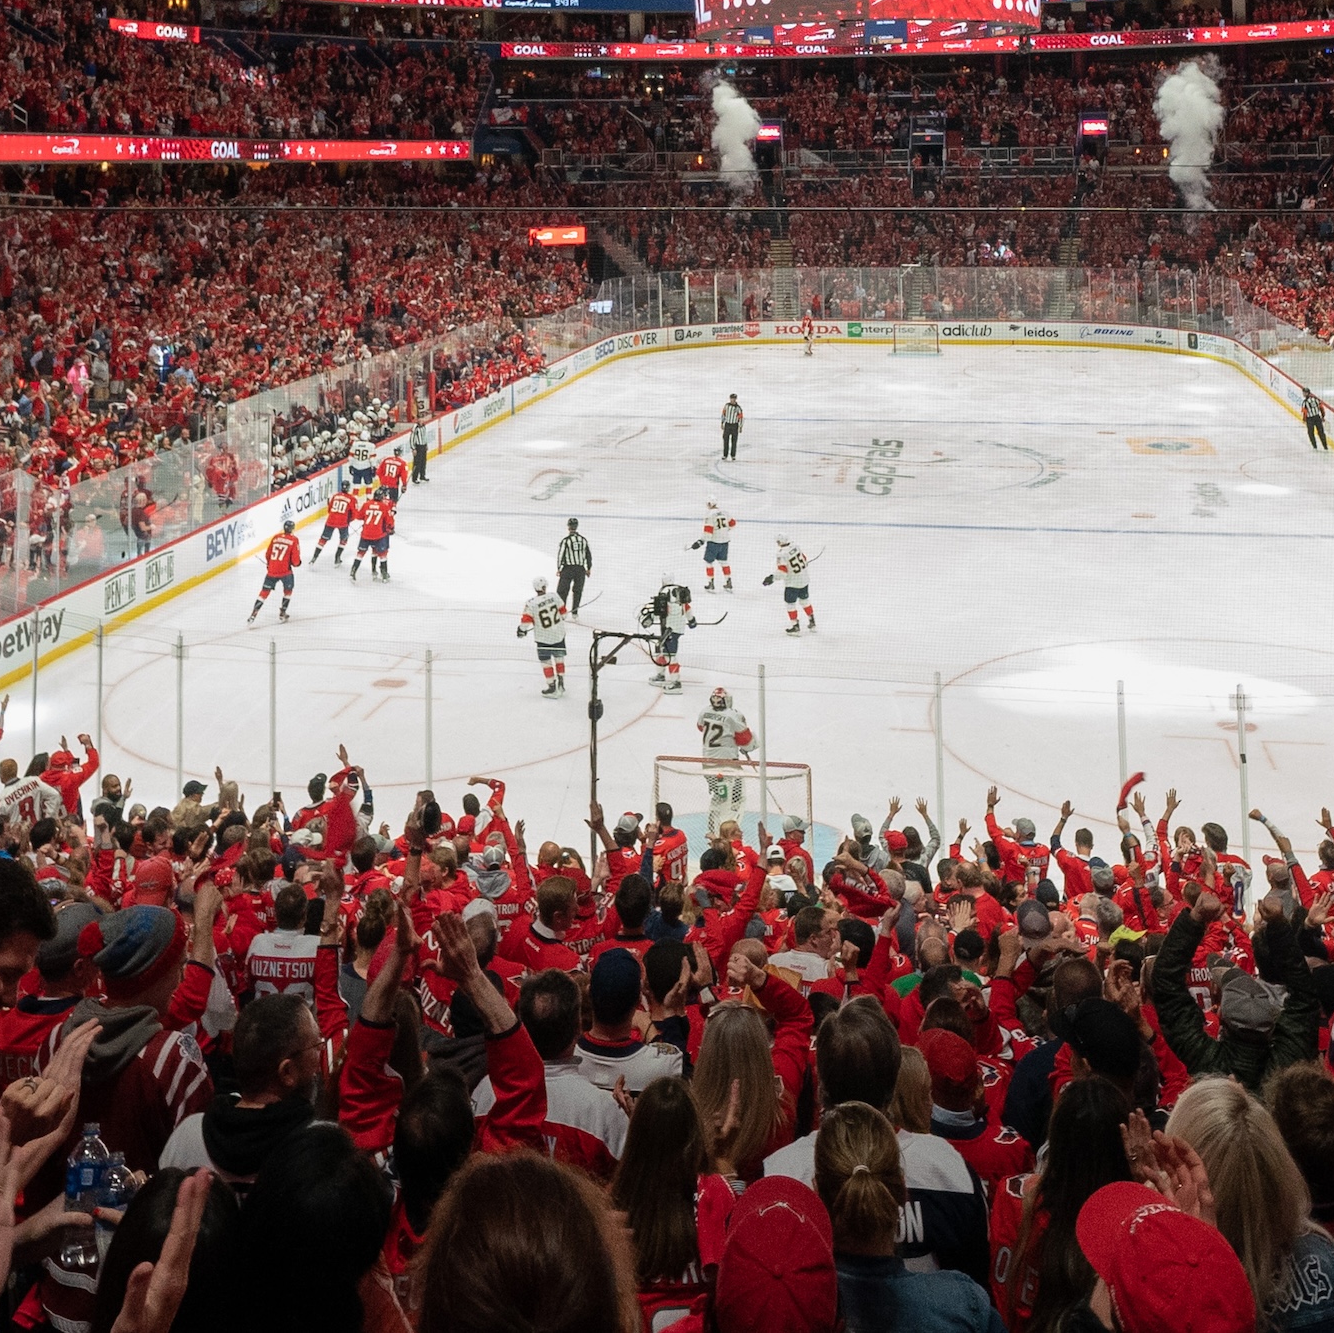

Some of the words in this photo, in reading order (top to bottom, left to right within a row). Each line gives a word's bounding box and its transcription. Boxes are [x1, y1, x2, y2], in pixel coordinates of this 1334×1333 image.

[156, 25, 184, 38] GOAL
[1090, 35, 1124, 45] GOAL
[514, 45, 546, 55] GOAL
[796, 45, 828, 54] GOAL
[211, 141, 240, 159] GOAL
[942, 324, 992, 337] adiclub
[1023, 327, 1059, 338] leidos
[1094, 328, 1134, 336] BOEING
[384, 464, 398, 478] 19
[330, 500, 348, 513] 90
[365, 510, 383, 525] 77
[206, 521, 237, 562] BEVY
[270, 544, 288, 561] 57
[538, 605, 561, 630] 62
